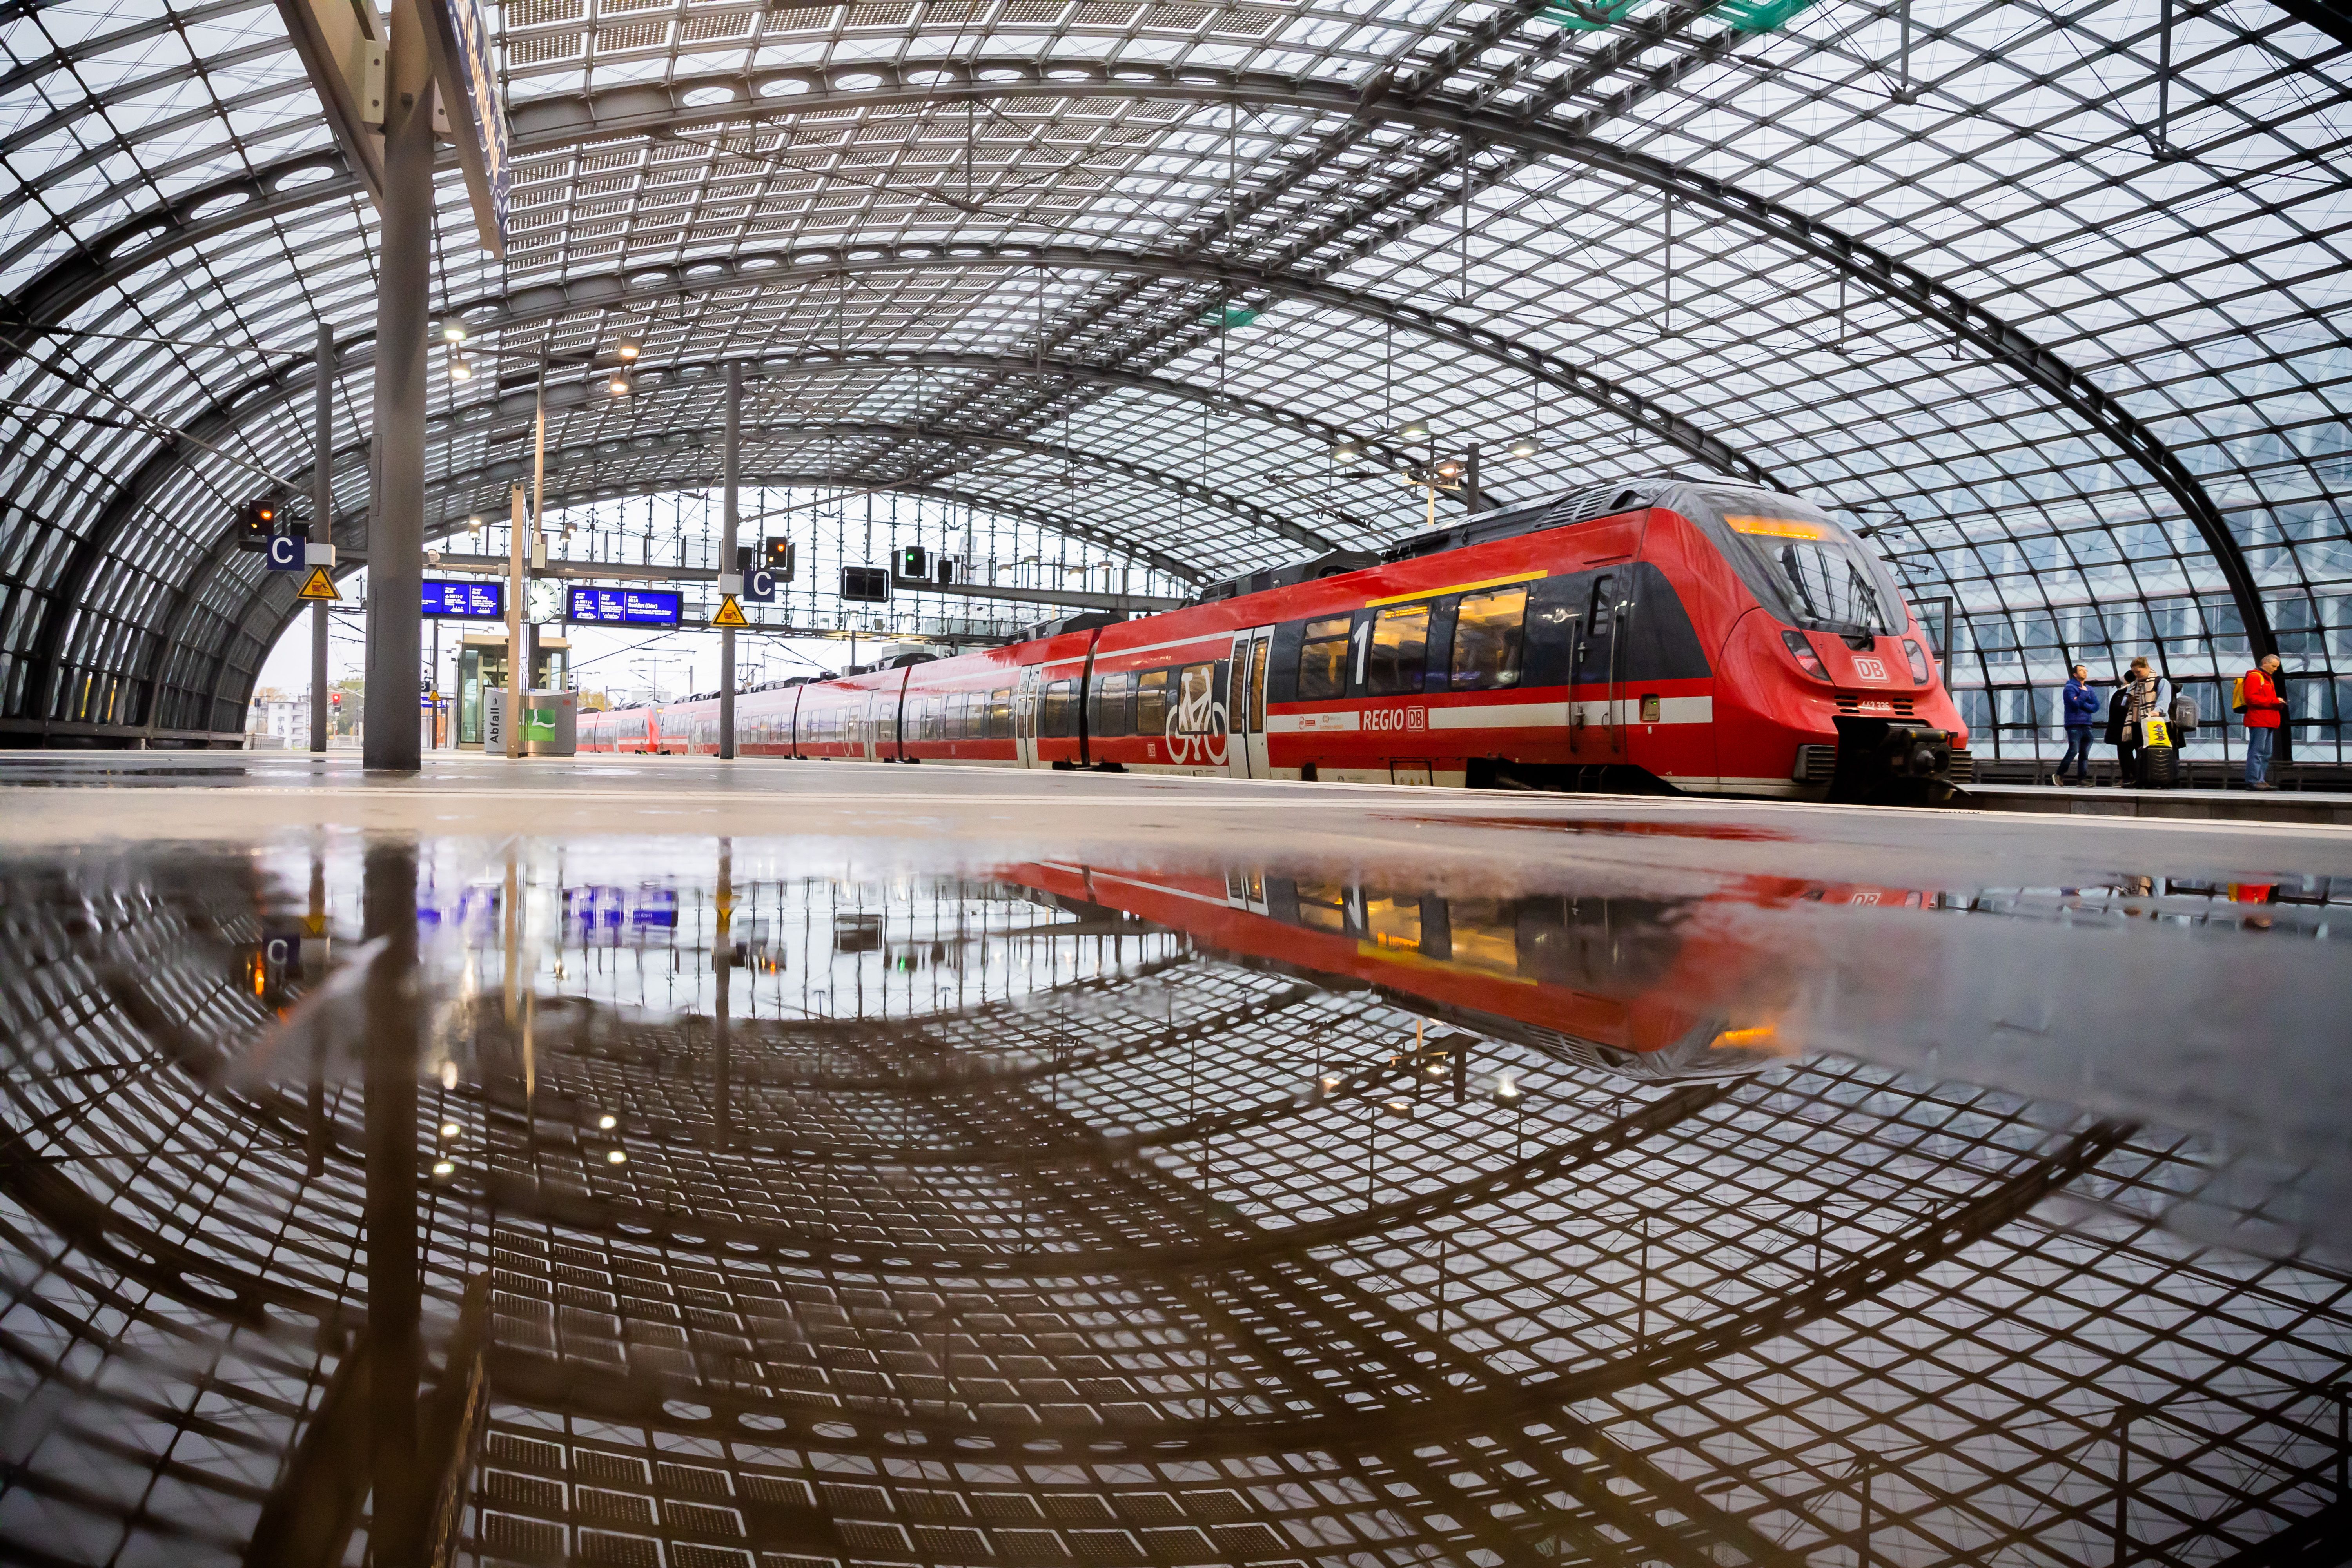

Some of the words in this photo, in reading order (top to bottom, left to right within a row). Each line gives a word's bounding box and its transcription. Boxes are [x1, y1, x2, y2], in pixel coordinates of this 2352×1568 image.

[272, 537, 293, 563] C
[754, 572, 771, 595] C
[1354, 621, 1369, 684] 1
[1857, 660, 1885, 678] DB
[490, 708, 499, 743] Abfall
[1363, 708, 1404, 731] REGIO
[1408, 710, 1423, 727] DB
